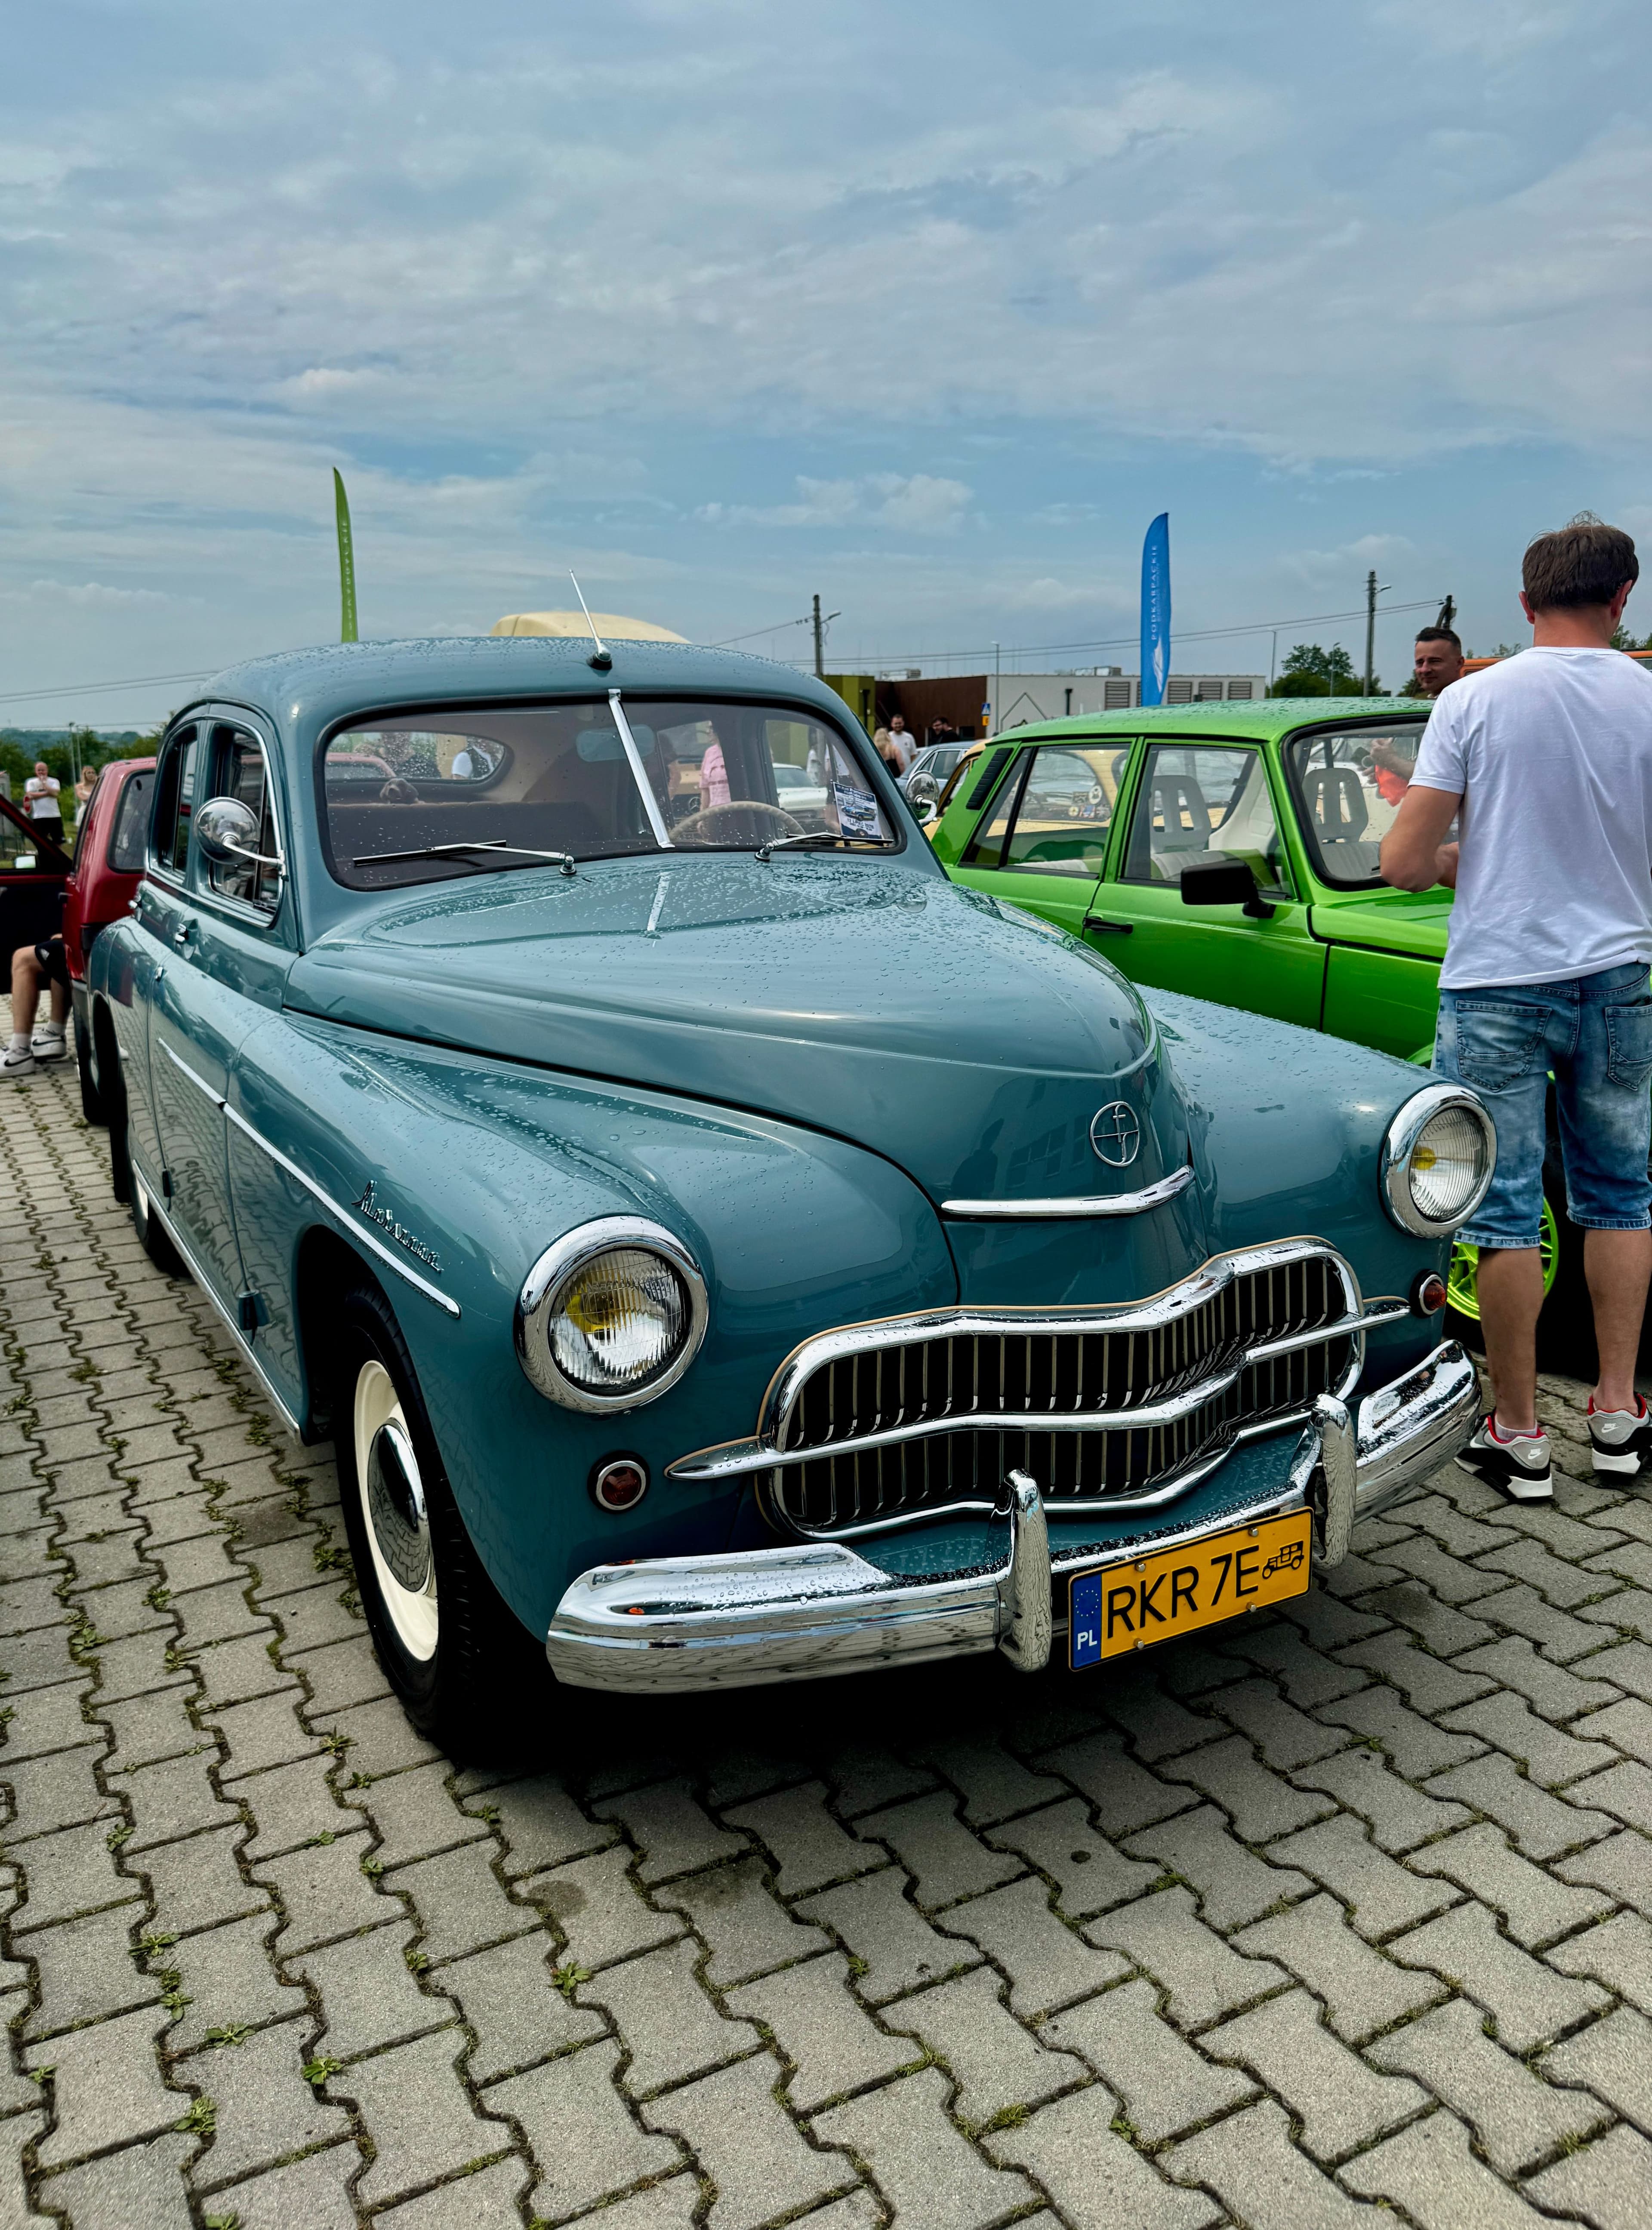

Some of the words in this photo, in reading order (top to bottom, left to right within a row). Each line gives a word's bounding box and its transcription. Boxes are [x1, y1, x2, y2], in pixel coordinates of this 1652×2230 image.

[1107, 1565, 1199, 1639] RKR
[1211, 1544, 1259, 1607] 7E
[1077, 1629, 1097, 1650] PL
